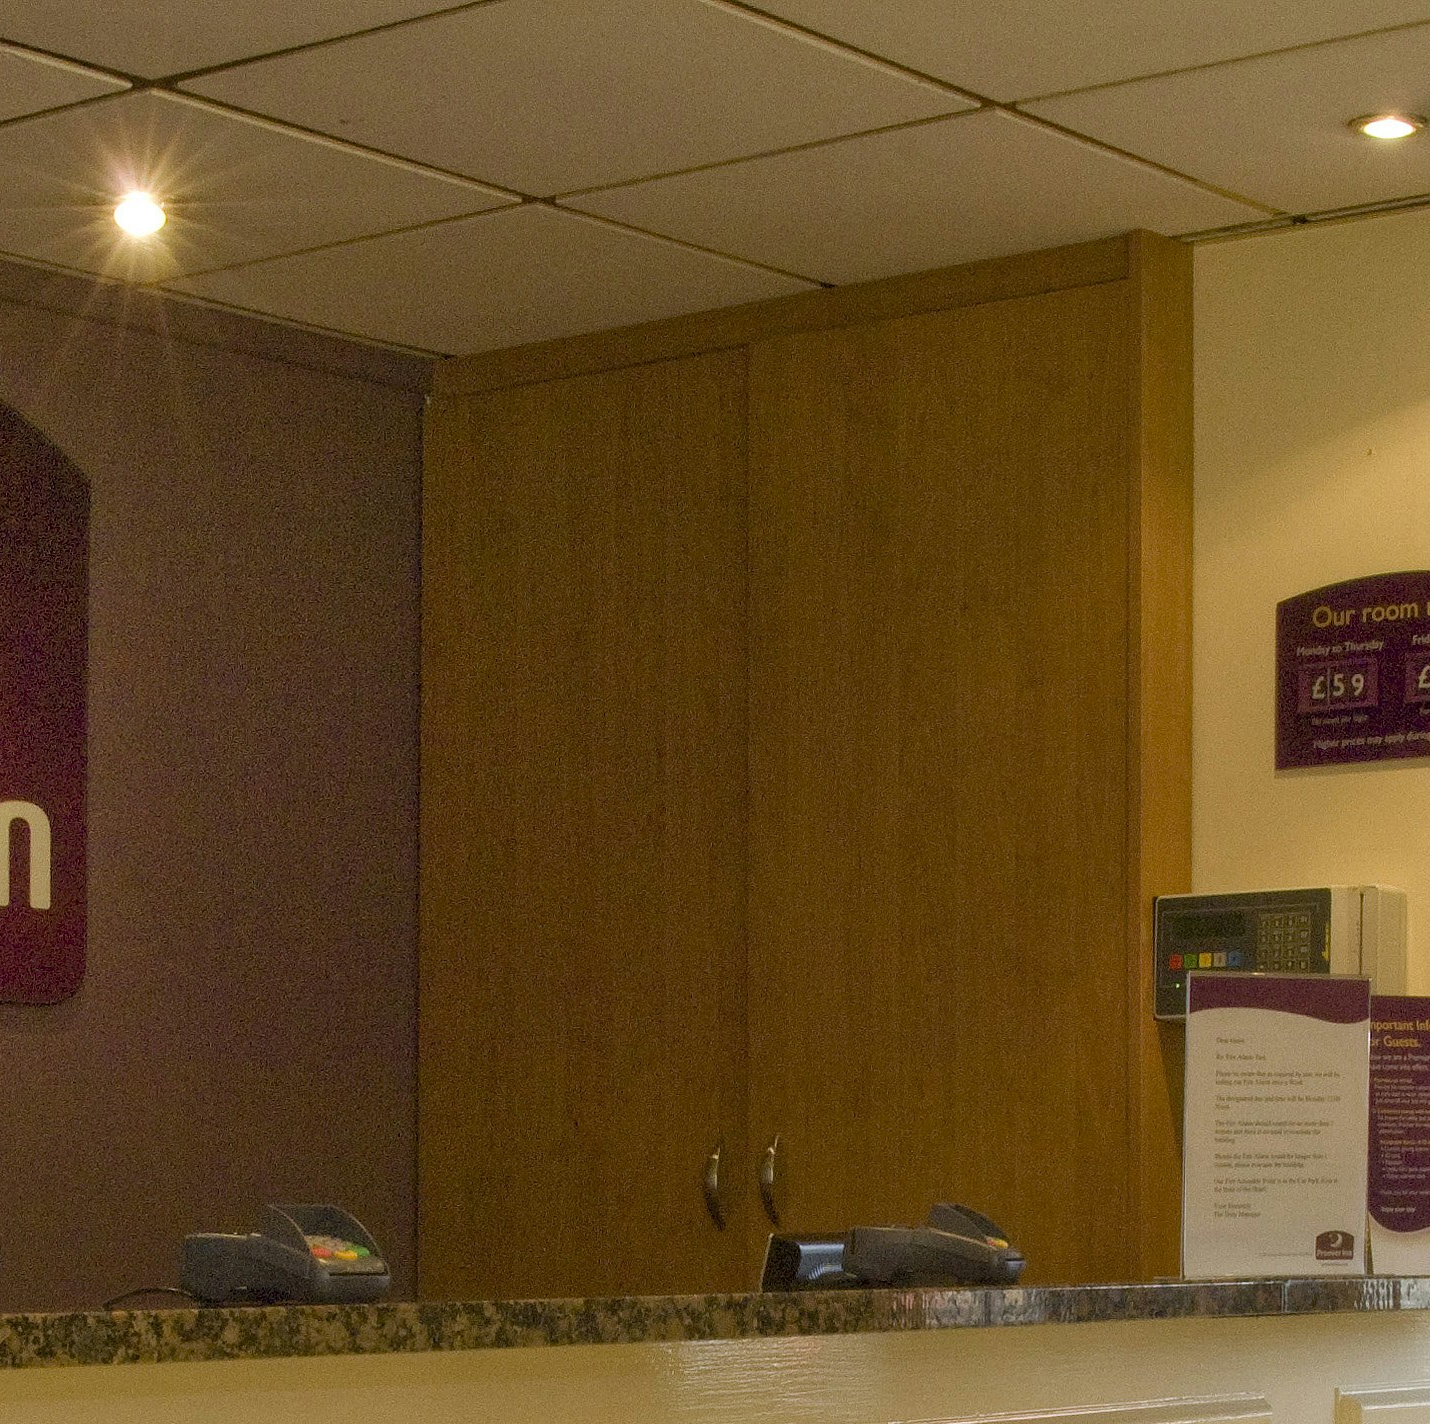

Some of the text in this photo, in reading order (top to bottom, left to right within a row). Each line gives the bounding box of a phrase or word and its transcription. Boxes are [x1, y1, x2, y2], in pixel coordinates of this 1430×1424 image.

[1312, 605, 1356, 628] Our
[1361, 603, 1419, 623] room
[1344, 639, 1385, 652] Thursday
[1370, 1021, 1415, 1034] mportant
[1370, 1037, 1380, 1047] or
